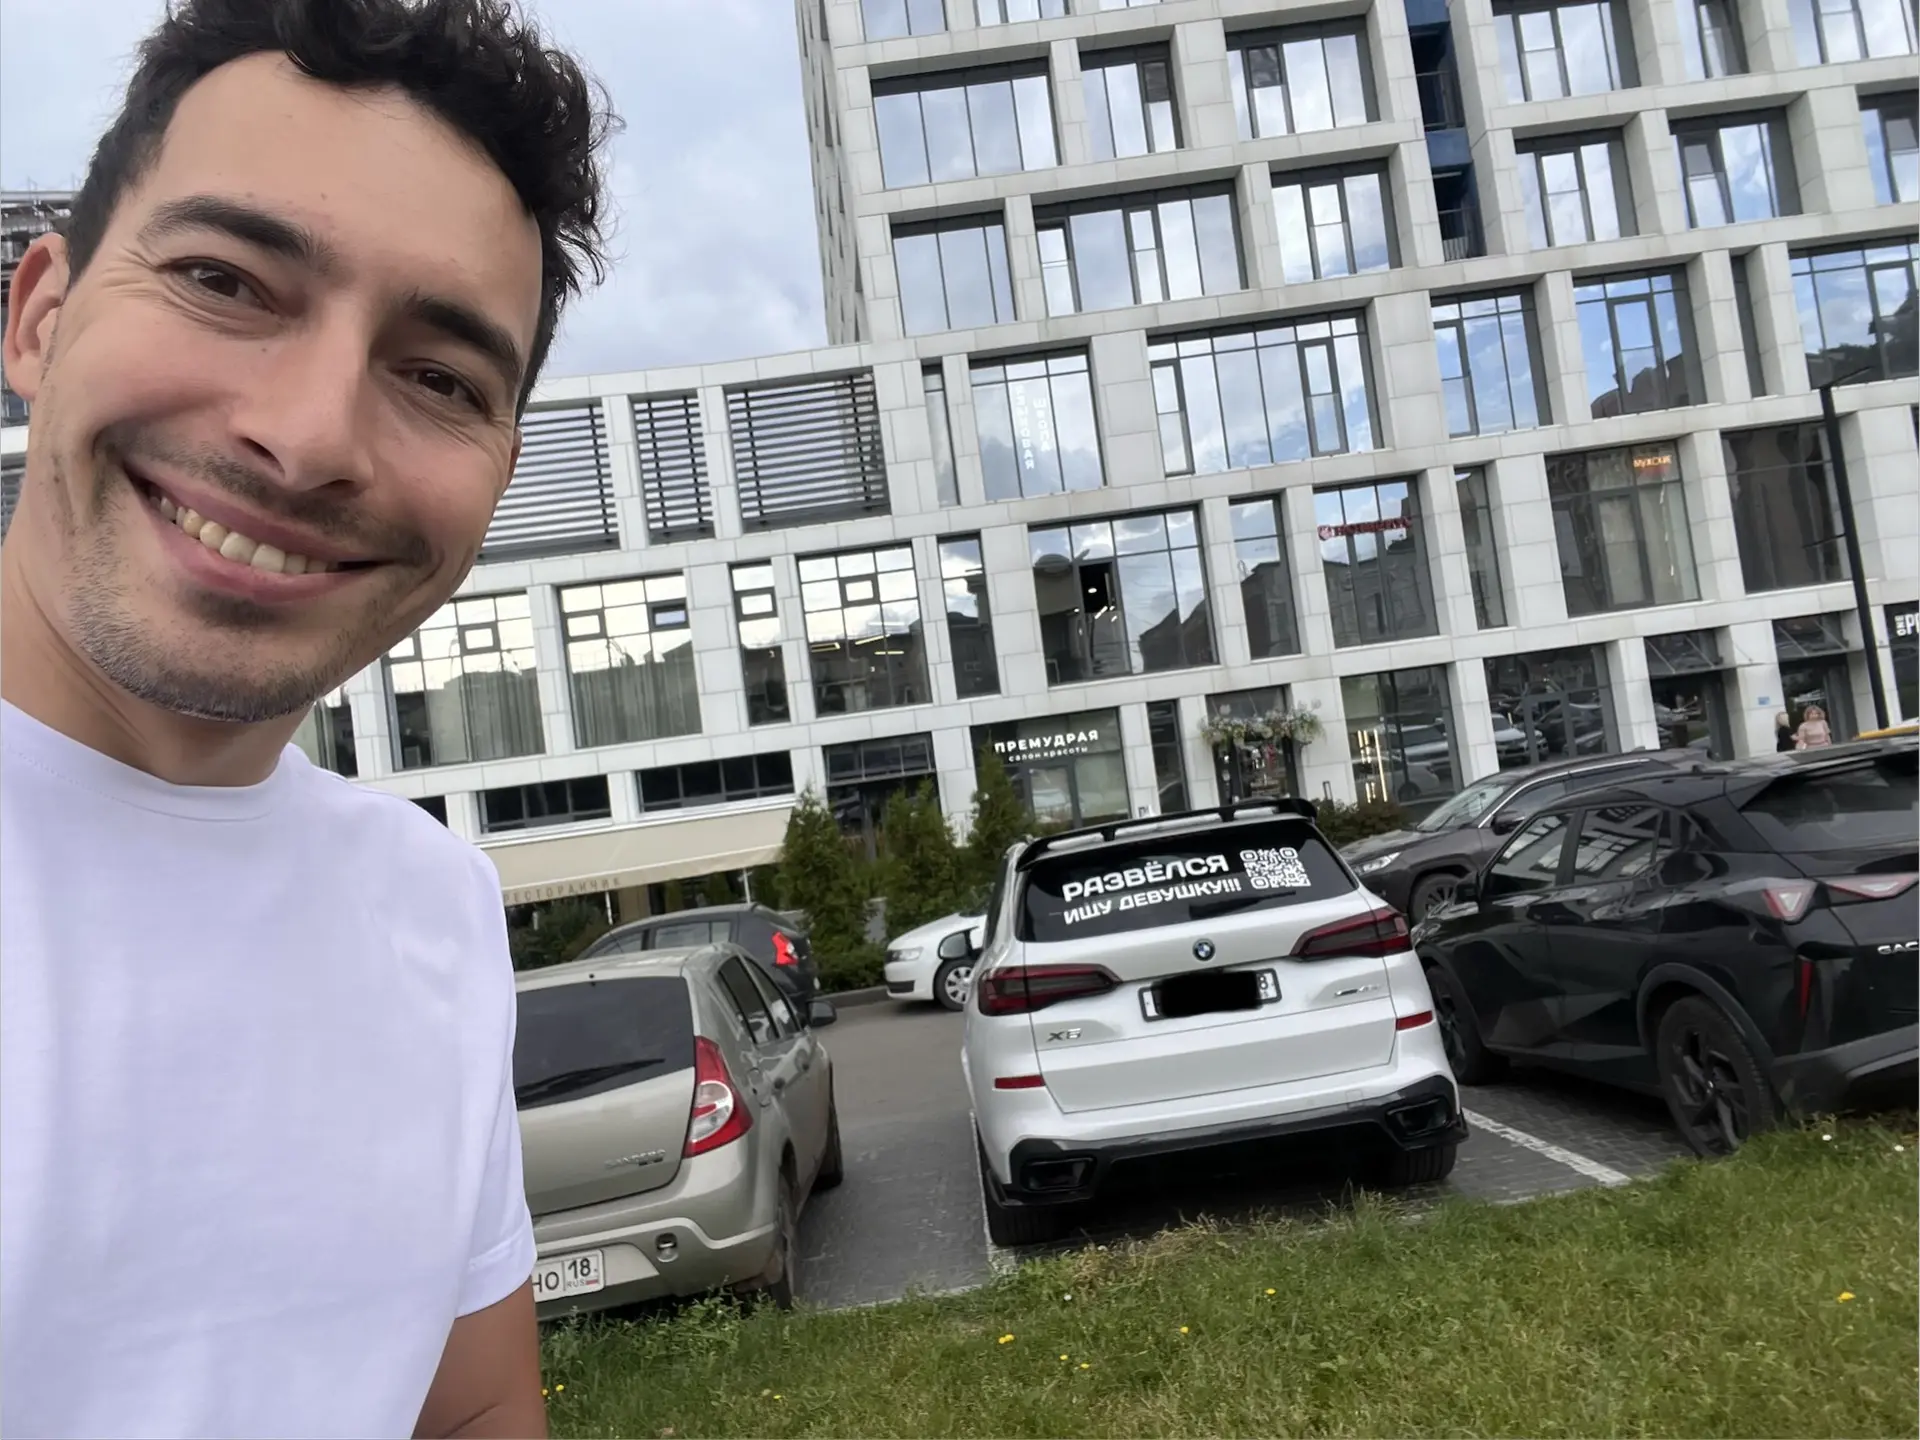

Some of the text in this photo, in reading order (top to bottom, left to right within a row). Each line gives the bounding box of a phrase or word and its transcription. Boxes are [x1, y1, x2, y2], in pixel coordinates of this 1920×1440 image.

[994, 729, 1099, 753] ПРЕМУДРАЯ
[1062, 854, 1229, 902] РАЗВЁЛСЯ
[1063, 877, 1242, 925] ИЩУ ДЕВУШКУ!!!
[568, 1257, 591, 1279] 18
